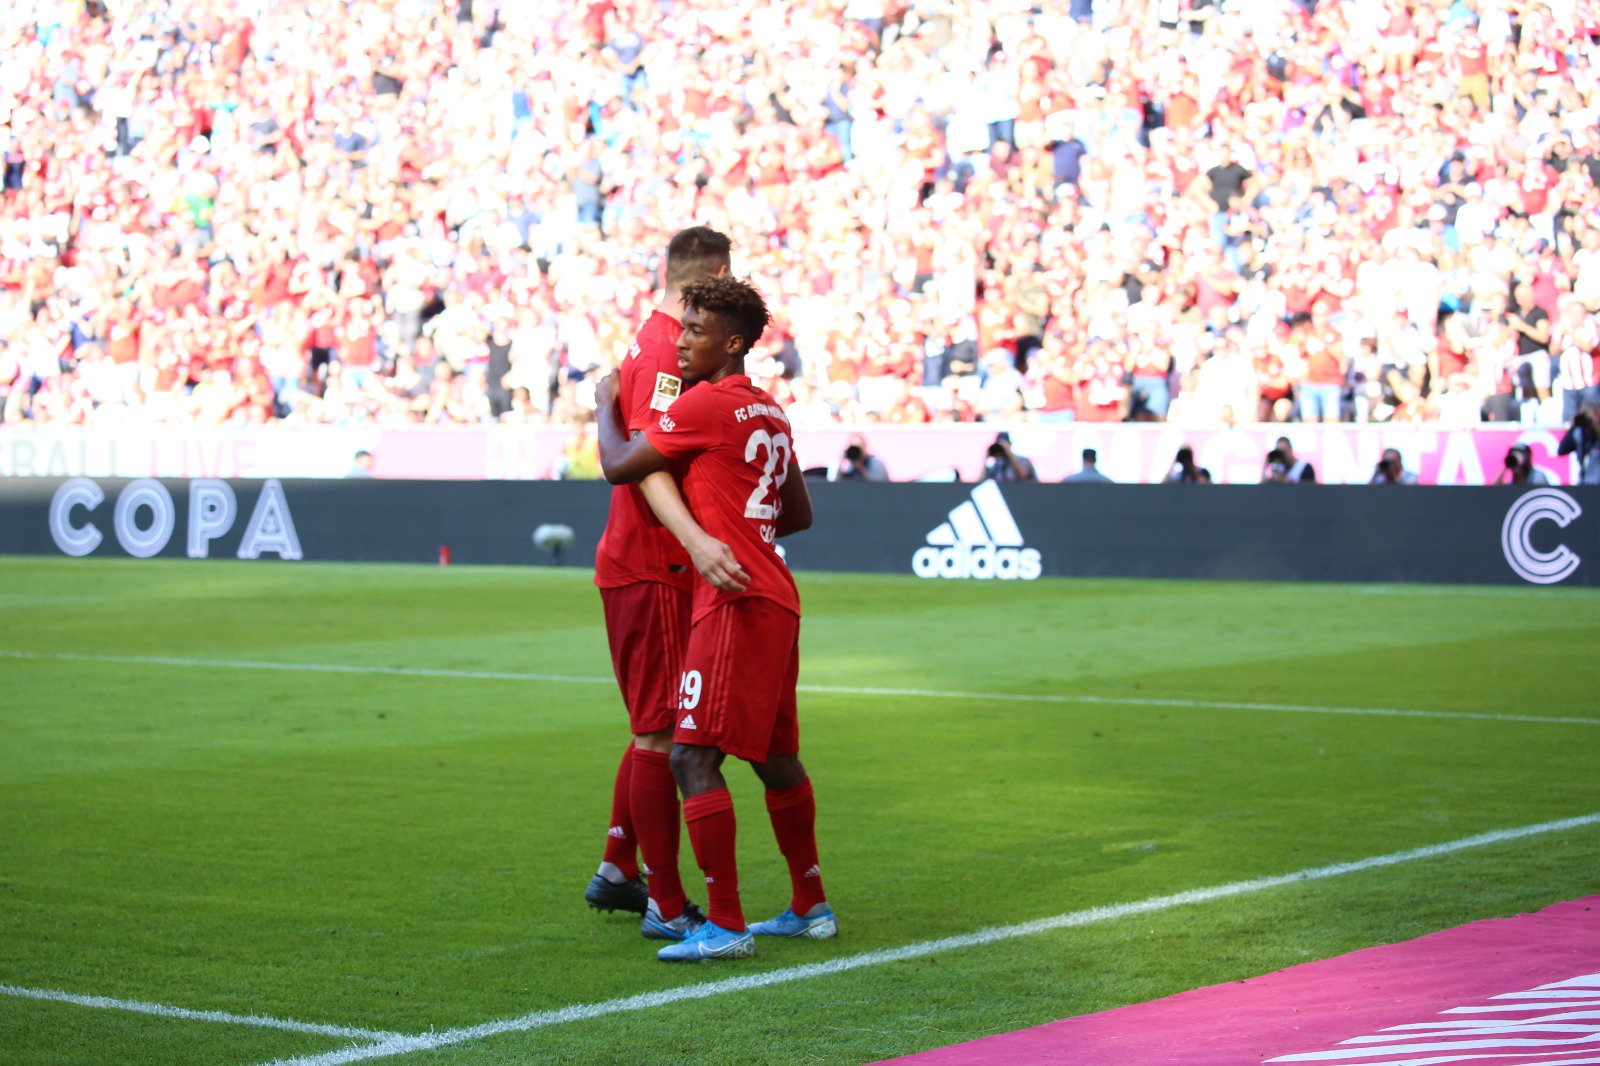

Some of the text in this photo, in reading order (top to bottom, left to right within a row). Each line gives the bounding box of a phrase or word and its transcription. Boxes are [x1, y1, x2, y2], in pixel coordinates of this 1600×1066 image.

[734, 407, 748, 422] FC
[0, 440, 118, 478] BALL
[49, 477, 303, 560] COPA
[1502, 487, 1582, 584] C
[912, 542, 1042, 580] adidas
